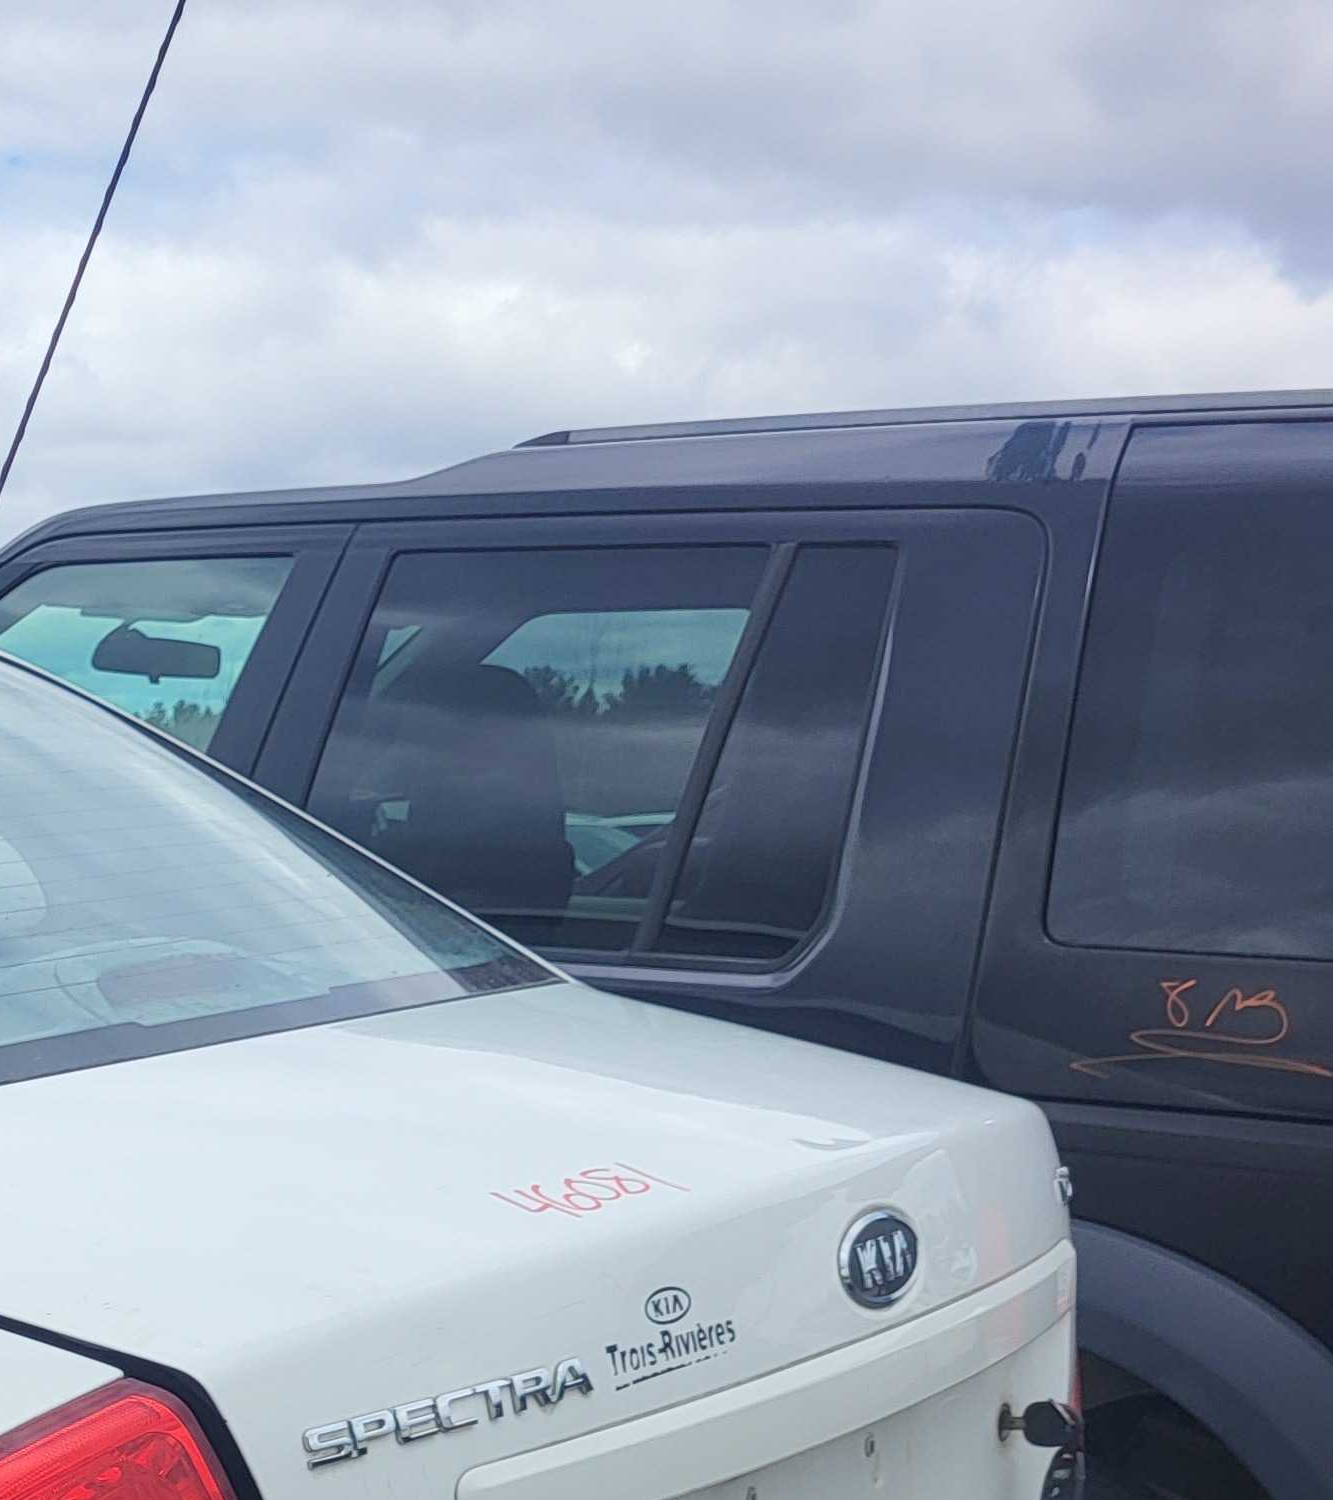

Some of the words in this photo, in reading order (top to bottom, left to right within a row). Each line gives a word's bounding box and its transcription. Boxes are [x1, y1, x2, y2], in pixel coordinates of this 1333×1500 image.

[489, 1161, 692, 1219] 46081
[852, 1229, 912, 1289] KIA
[651, 1294, 684, 1317] KIA
[605, 1319, 737, 1377] Trois-Rivières
[302, 1356, 594, 1471] SPECTRA
